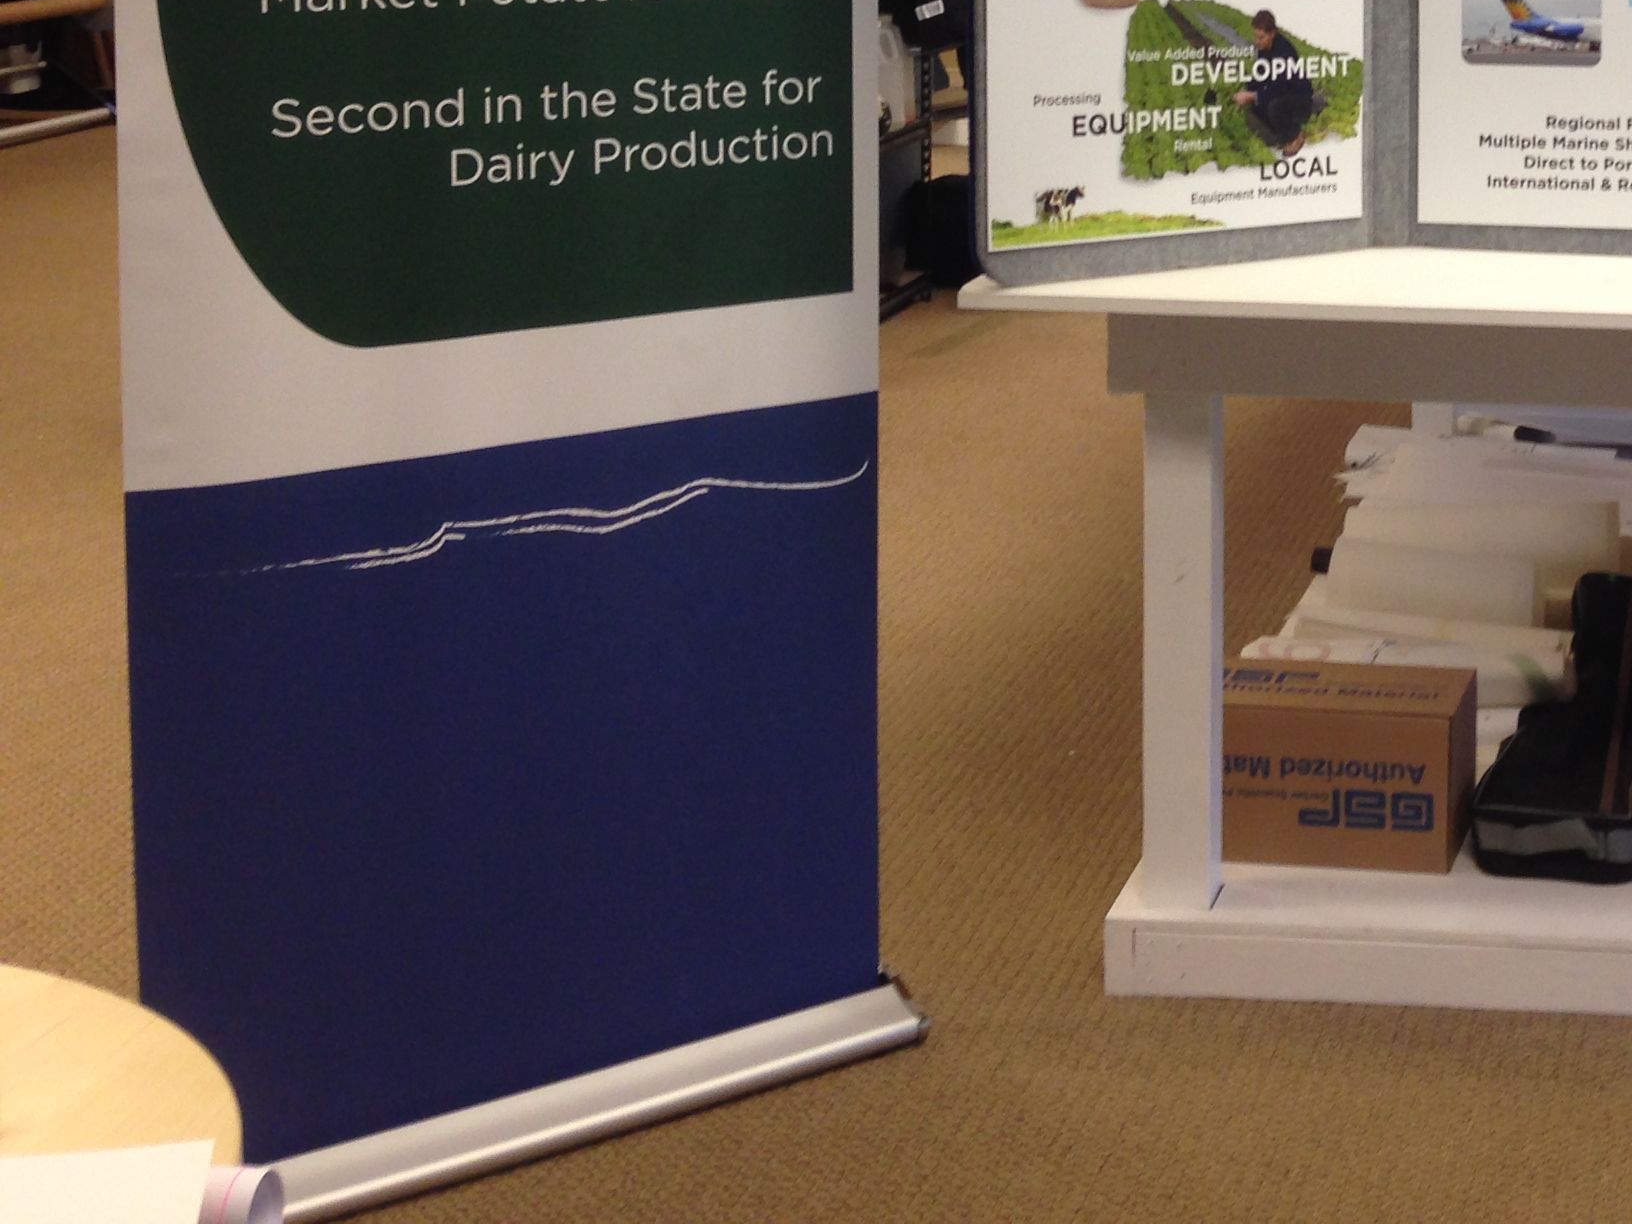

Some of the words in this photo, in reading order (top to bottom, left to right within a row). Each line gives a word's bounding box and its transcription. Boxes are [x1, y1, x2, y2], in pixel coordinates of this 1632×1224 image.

[1127, 49, 1161, 62] Value
[1164, 46, 1205, 61] Added
[1208, 45, 1256, 59] Product
[1171, 55, 1350, 86] DEVELOPMENT
[270, 87, 466, 138] Second
[483, 87, 522, 125] in
[540, 82, 617, 120] the
[632, 75, 747, 116] State
[762, 69, 822, 108] for
[1033, 92, 1101, 108] Processing
[1072, 106, 1222, 138] EQUIPMENT
[1546, 116, 1621, 132] Regional
[1479, 134, 1546, 150] Multiple
[1553, 136, 1609, 151] Marine
[450, 144, 574, 187] Dairy
[594, 125, 834, 176] Production
[1260, 155, 1338, 181] LOCAL
[1524, 155, 1574, 170] Direct
[1581, 158, 1598, 170] to
[1190, 189, 1254, 205] Equipment
[1257, 183, 1338, 199] Manufacturers
[1487, 176, 1595, 191] International
[1601, 178, 1612, 191] &
[1223, 752, 1271, 779] Mat
[1280, 754, 1426, 785] Authorized
